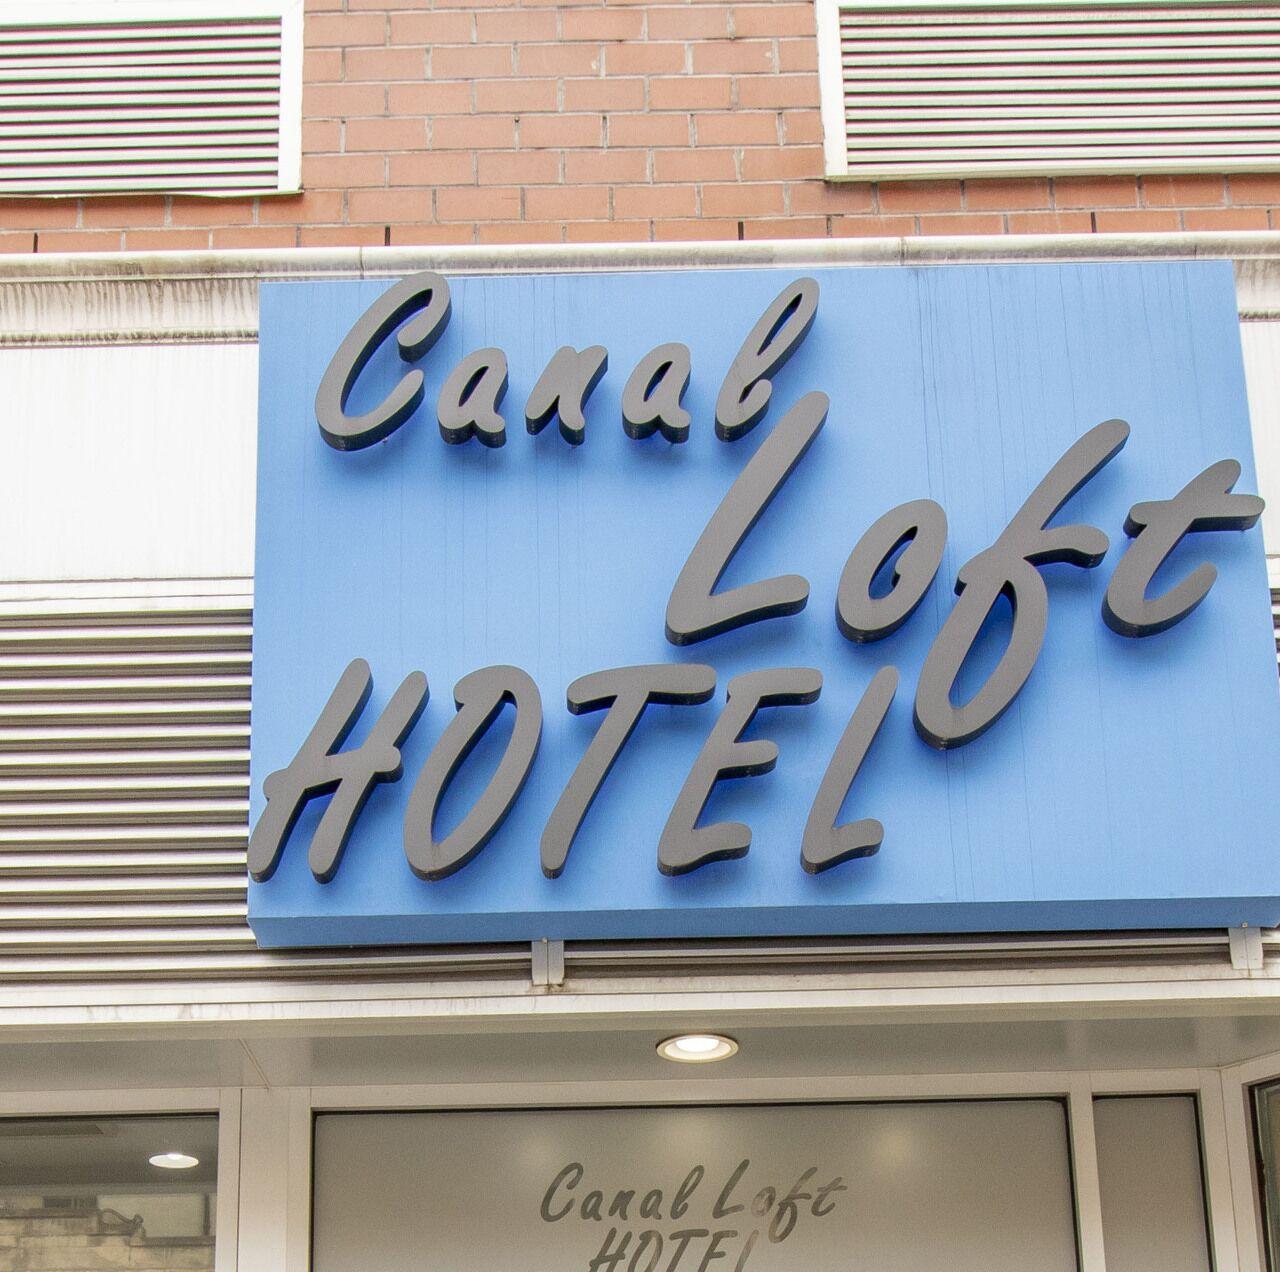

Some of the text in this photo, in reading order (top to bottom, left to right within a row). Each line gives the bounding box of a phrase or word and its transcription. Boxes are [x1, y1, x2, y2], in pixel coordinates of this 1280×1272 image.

[314, 271, 819, 451] Canal
[664, 390, 1265, 750] Loft
[247, 657, 900, 884] HOTEL
[540, 1159, 848, 1243] Canal Loft
